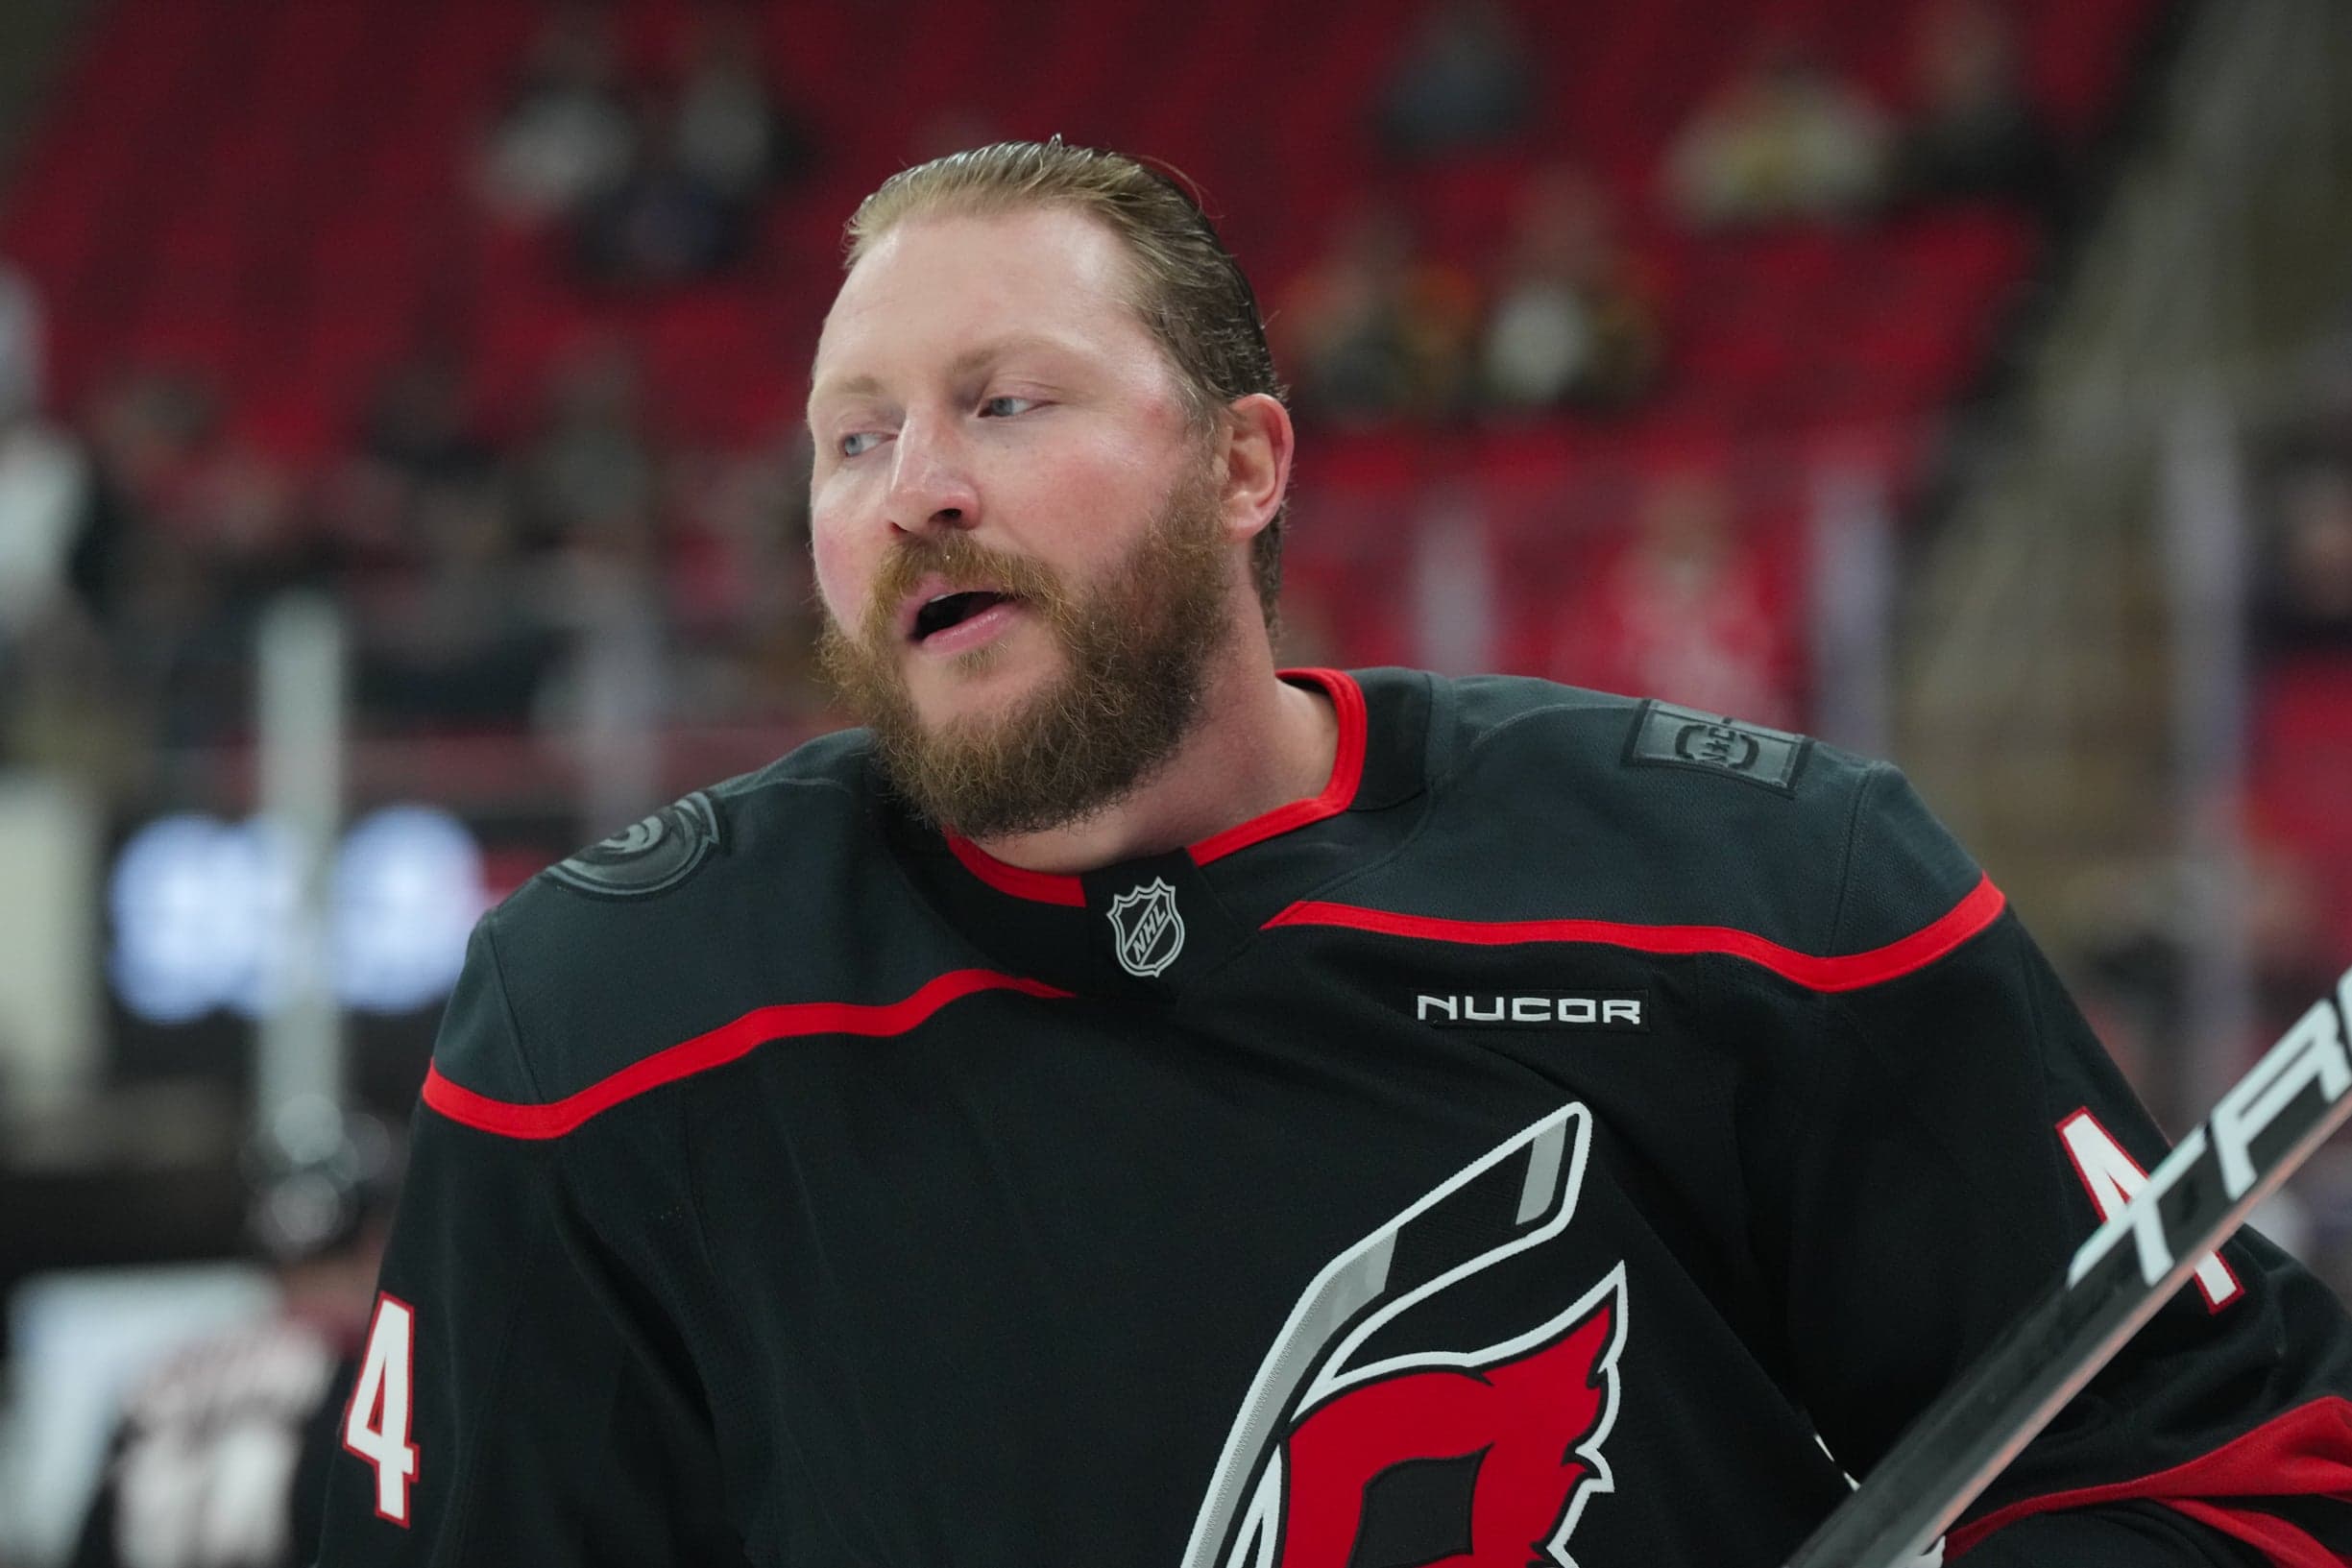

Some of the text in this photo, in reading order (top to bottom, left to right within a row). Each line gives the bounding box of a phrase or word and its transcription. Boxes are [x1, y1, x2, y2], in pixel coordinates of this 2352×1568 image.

[1132, 904, 1167, 962] NHL
[1417, 995, 1641, 1025] NUCOR
[343, 1291, 421, 1529] 4
